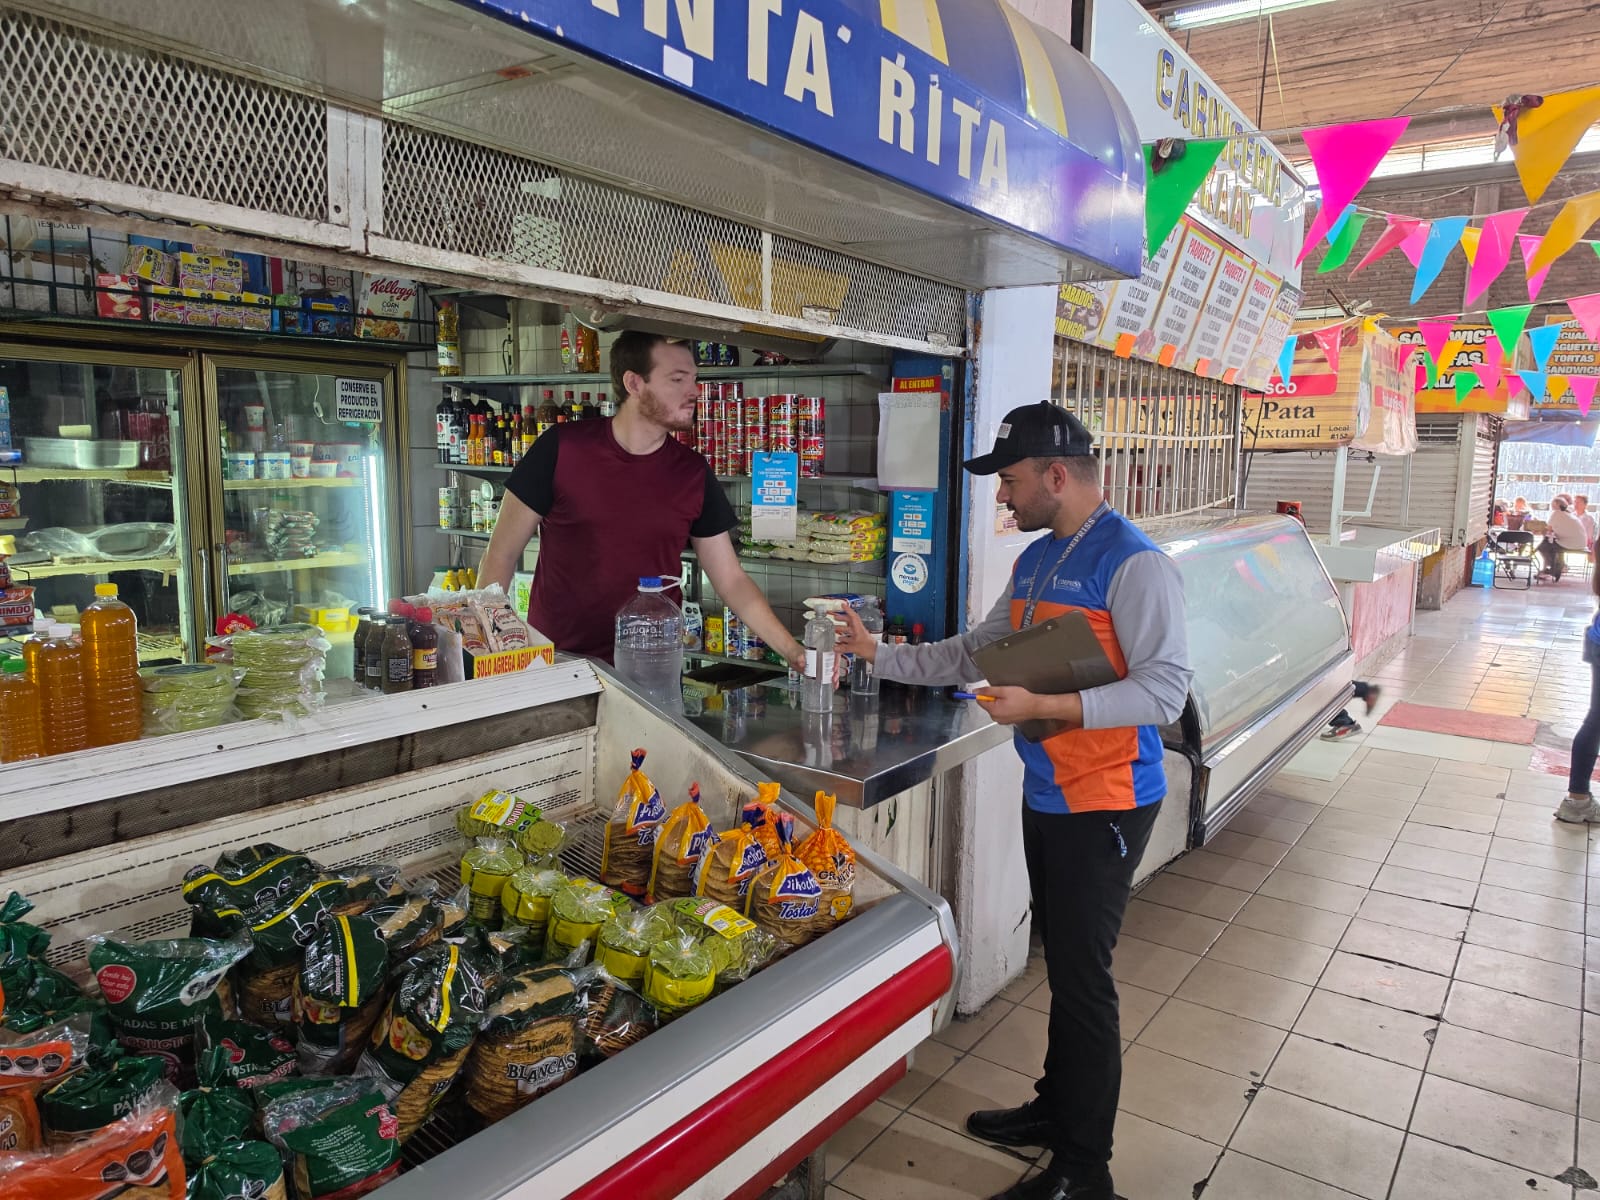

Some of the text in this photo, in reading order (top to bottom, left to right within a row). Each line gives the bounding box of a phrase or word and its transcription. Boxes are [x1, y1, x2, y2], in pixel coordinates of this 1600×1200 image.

[878, 56, 1010, 196] RITA
[1187, 237, 1212, 264] PAQUETE
[369, 278, 417, 302] Kellogg's
[1055, 316, 1087, 340] OMINGOS
[1554, 354, 1595, 363] TORTAS
[341, 381, 377, 394] CONSERVE EL
[340, 394, 378, 407] PRODUCTO EN
[338, 407, 381, 420] REFRIGERACIÓN
[1262, 401, 1315, 420] Pata
[1245, 424, 1320, 440] Nixtamal
[0, 605, 31, 616] IMBO
[476, 658, 491, 678] SOLO
[493, 654, 516, 675] AGREGA
[516, 651, 531, 671] AGUA
[507, 1052, 577, 1082] BLANCAS
